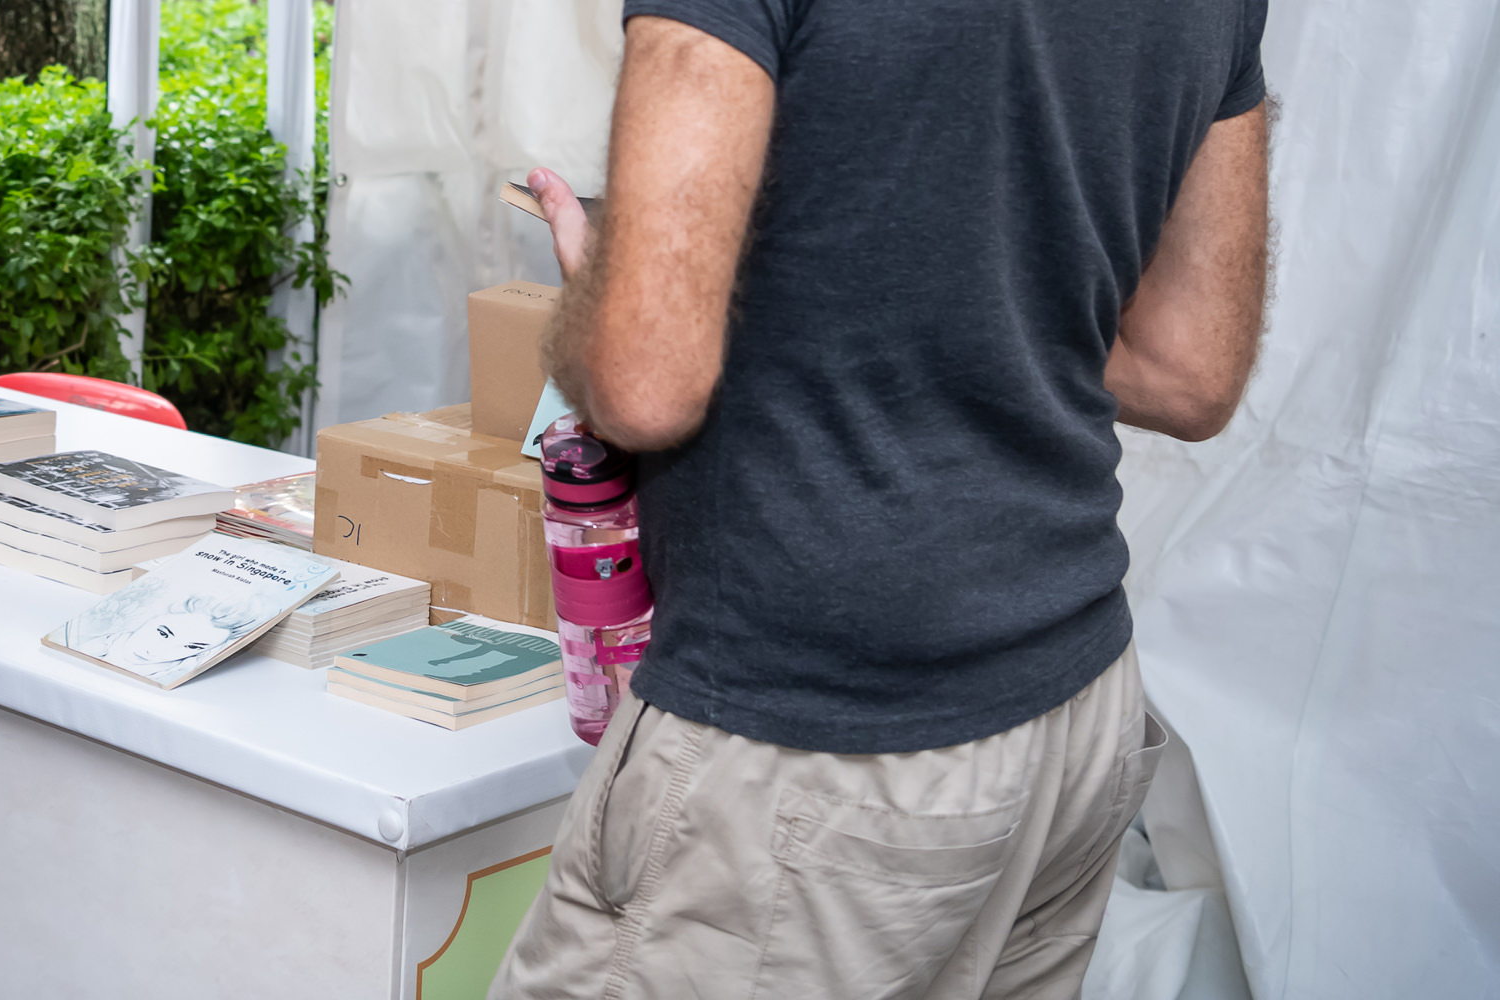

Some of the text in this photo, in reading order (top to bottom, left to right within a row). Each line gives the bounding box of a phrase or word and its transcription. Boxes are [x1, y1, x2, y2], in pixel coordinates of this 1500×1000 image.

[195, 551, 292, 586] snow in Singapore
[219, 549, 231, 557] The
[259, 563, 278, 572] made
